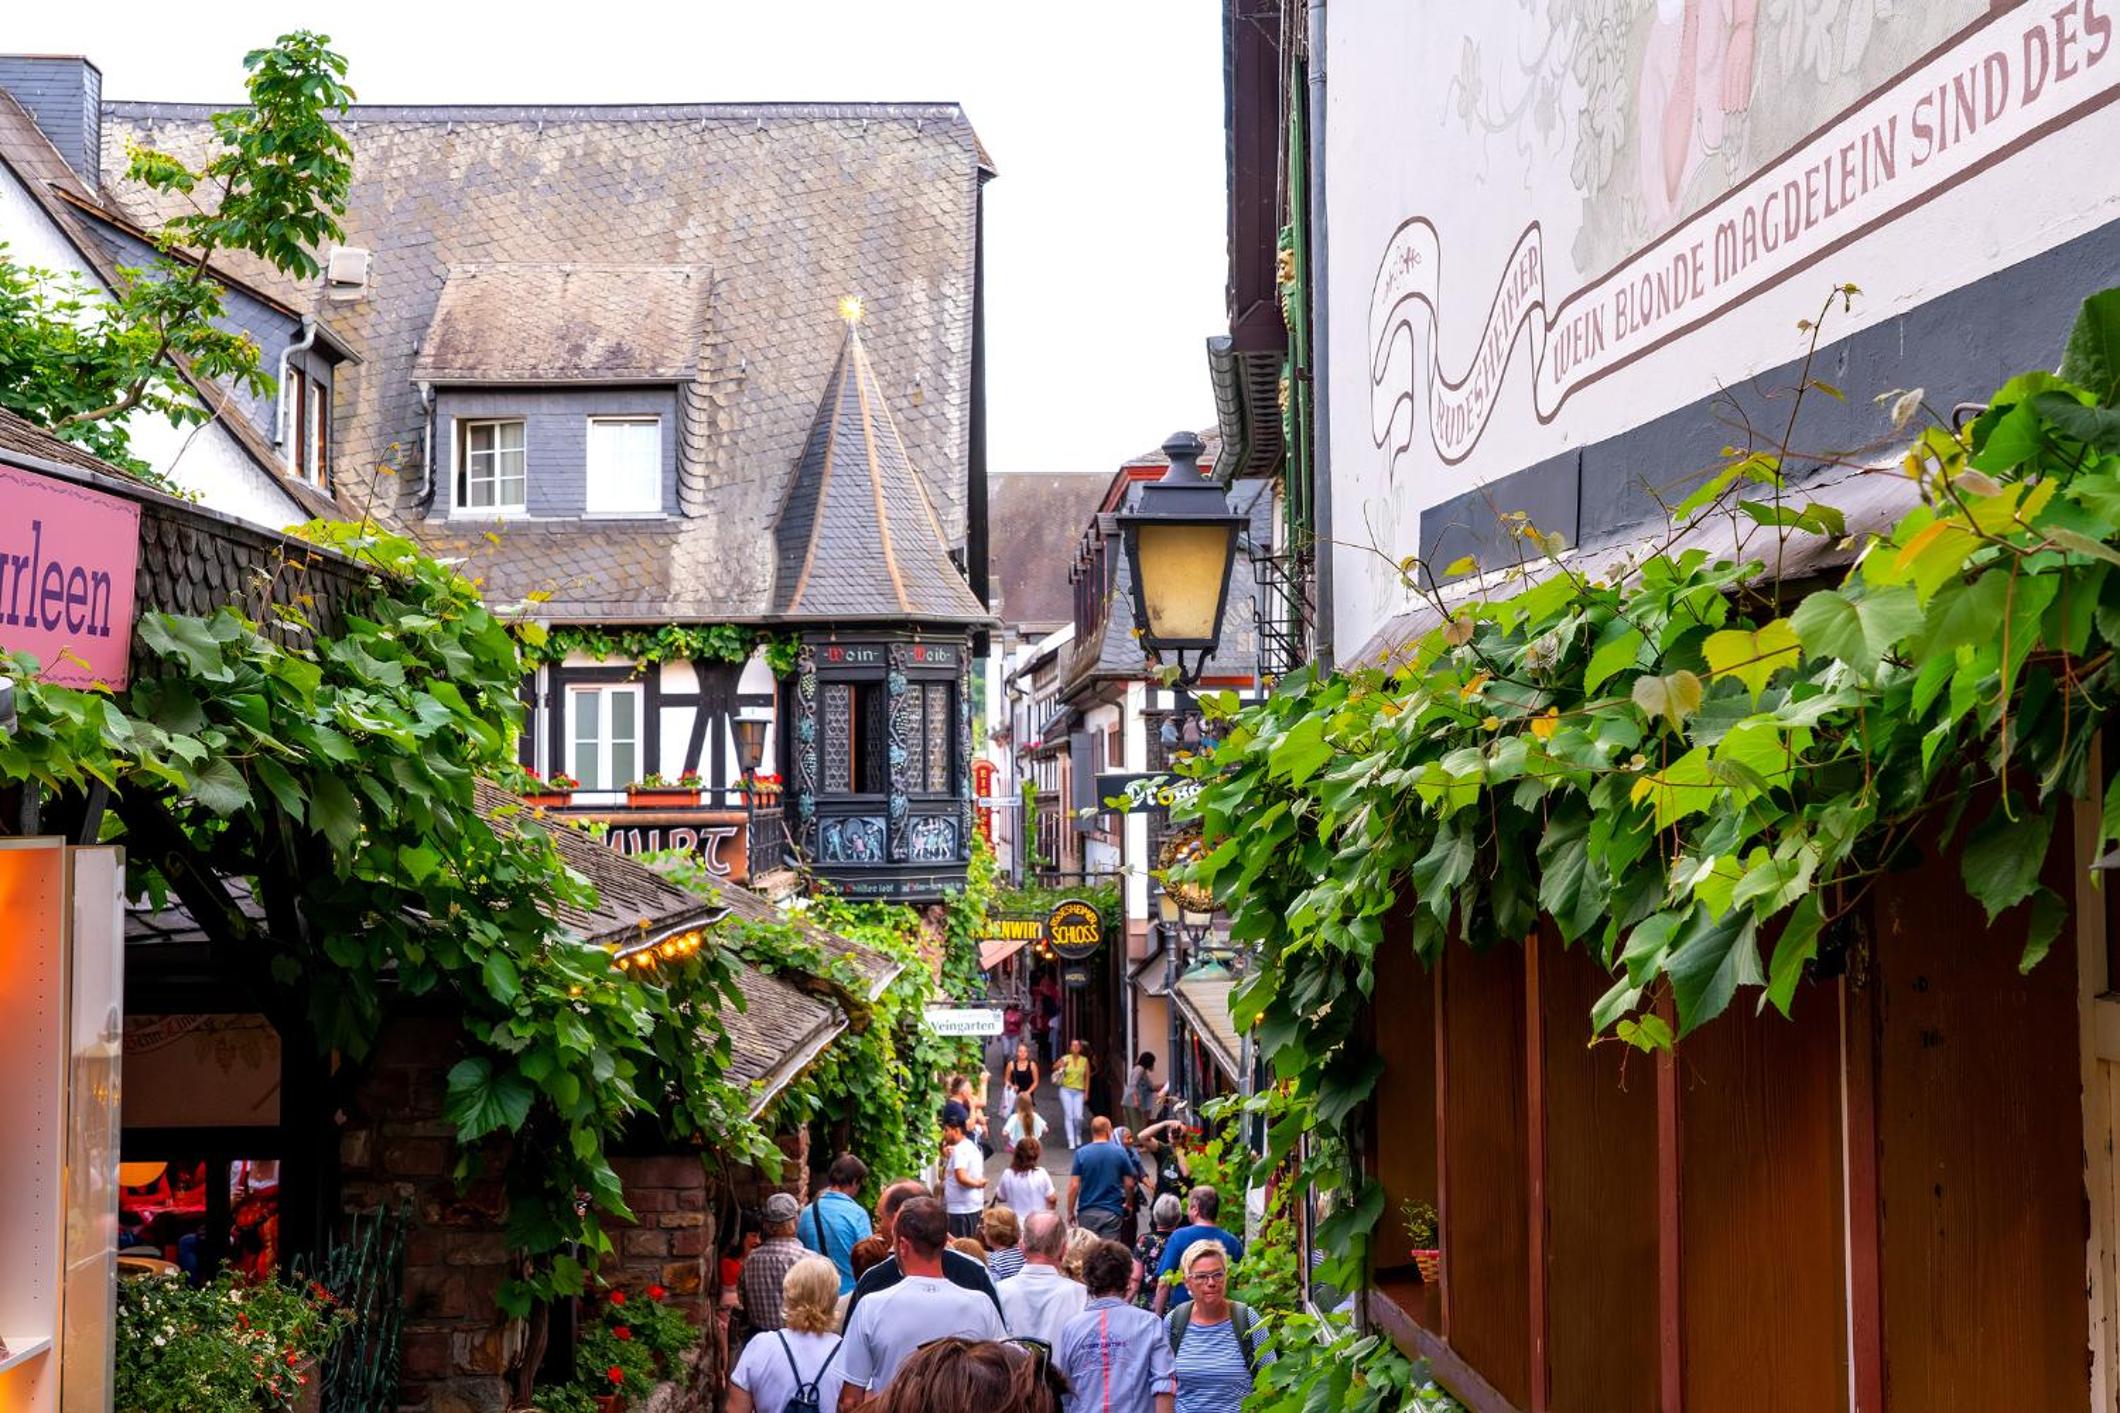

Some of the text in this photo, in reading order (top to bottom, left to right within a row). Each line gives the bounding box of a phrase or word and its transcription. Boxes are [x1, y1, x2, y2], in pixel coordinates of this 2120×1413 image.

[1553, 0, 2112, 384] WEIN BLONDE MAGDELEIN SIND DES
[1052, 925, 1099, 946] SCHLOSS
